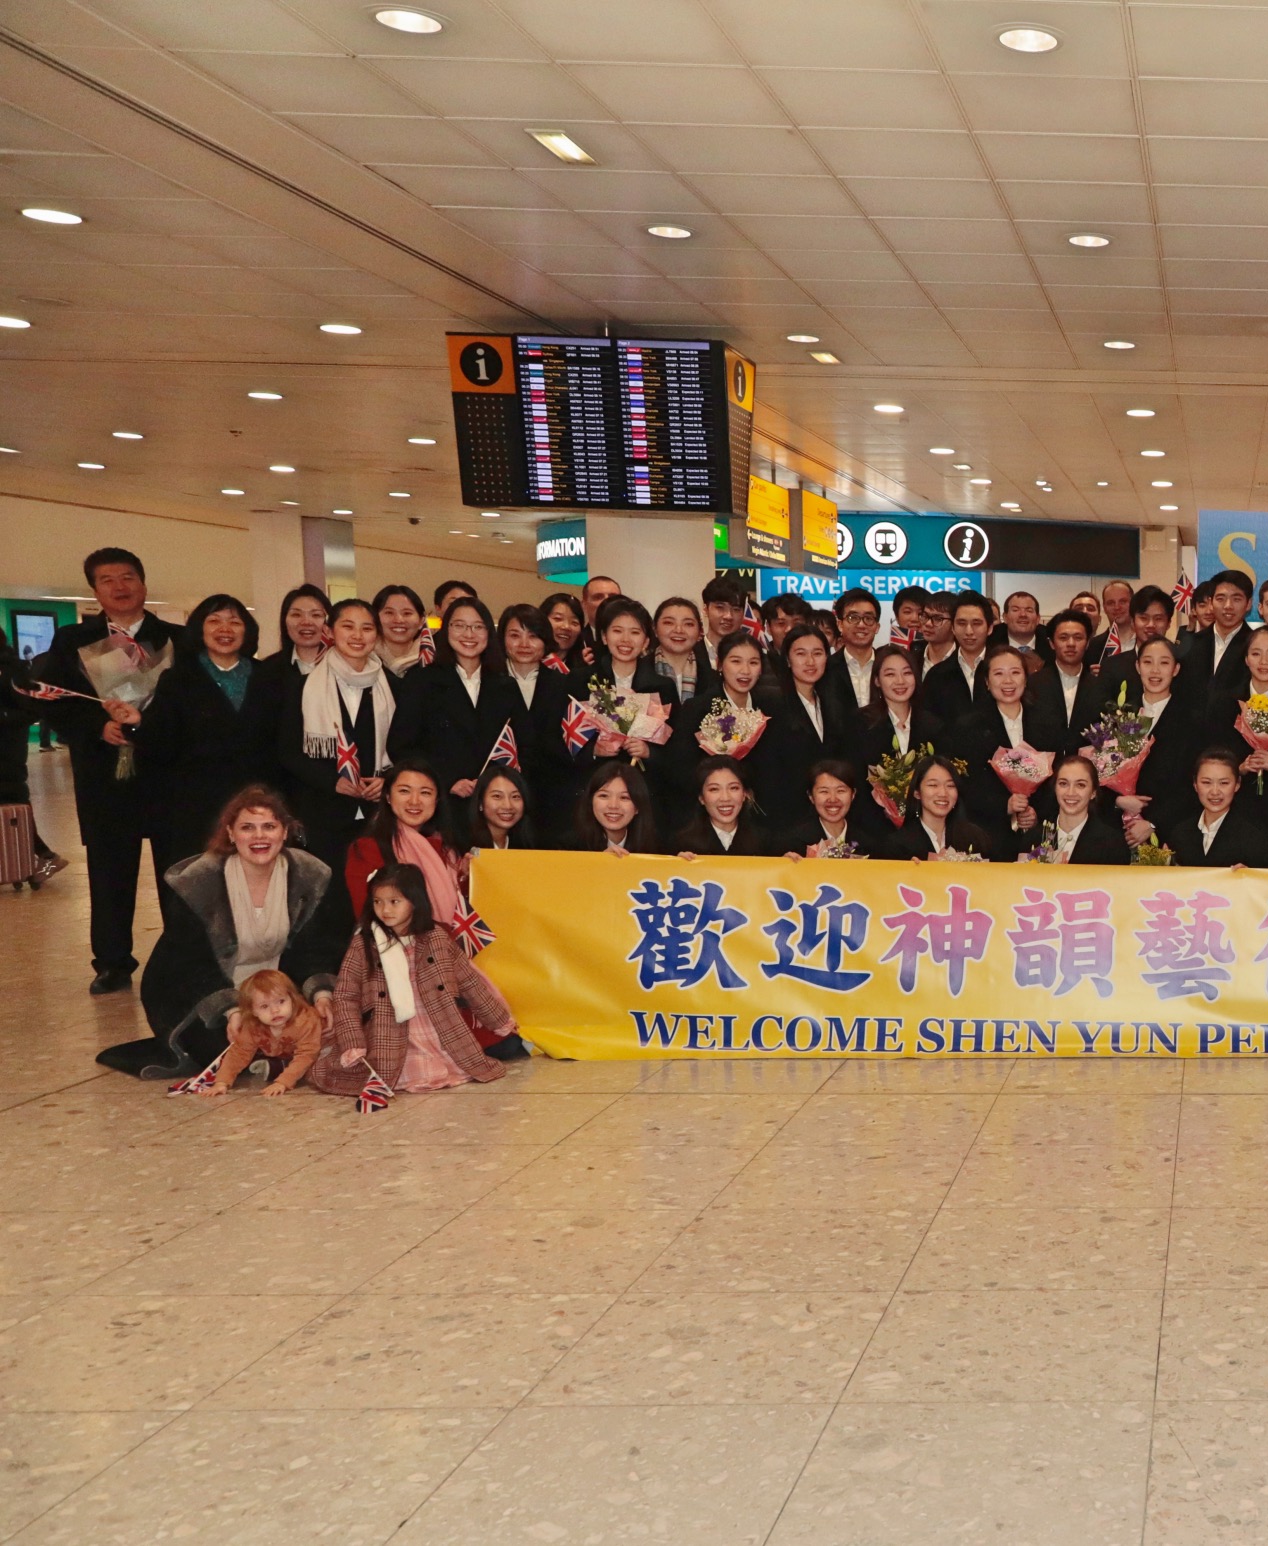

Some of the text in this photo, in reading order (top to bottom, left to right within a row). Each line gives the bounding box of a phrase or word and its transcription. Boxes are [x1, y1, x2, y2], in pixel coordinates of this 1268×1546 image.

[773, 576, 971, 595] TRAVEL SERVICES
[629, 1010, 904, 1053] WELCOME
[915, 1017, 1062, 1054] SHEN
[1071, 1021, 1183, 1054] YUN
